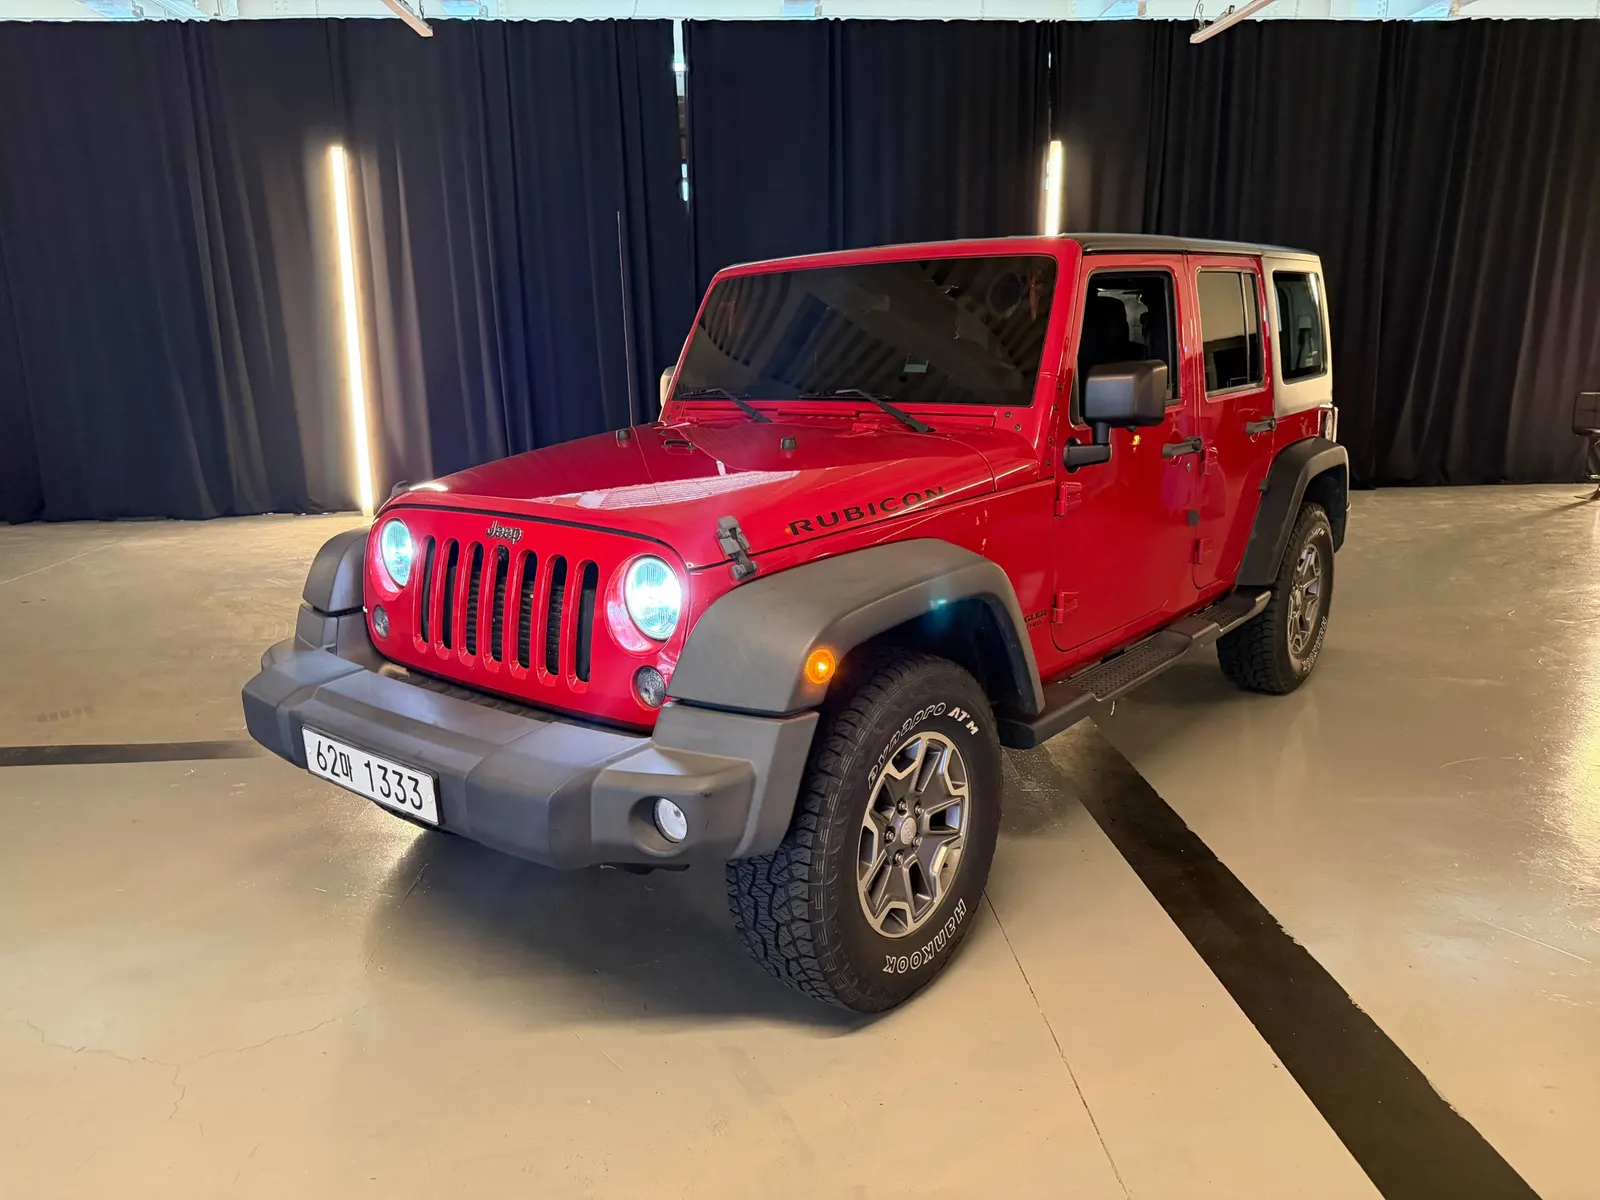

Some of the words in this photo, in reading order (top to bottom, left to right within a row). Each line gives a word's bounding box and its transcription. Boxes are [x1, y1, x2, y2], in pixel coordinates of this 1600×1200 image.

[788, 486, 944, 536] RUBICON
[486, 520, 523, 544] Jeep
[1024, 608, 1047, 623] GLER
[316, 740, 354, 783] 62마
[363, 760, 423, 811] 1333
